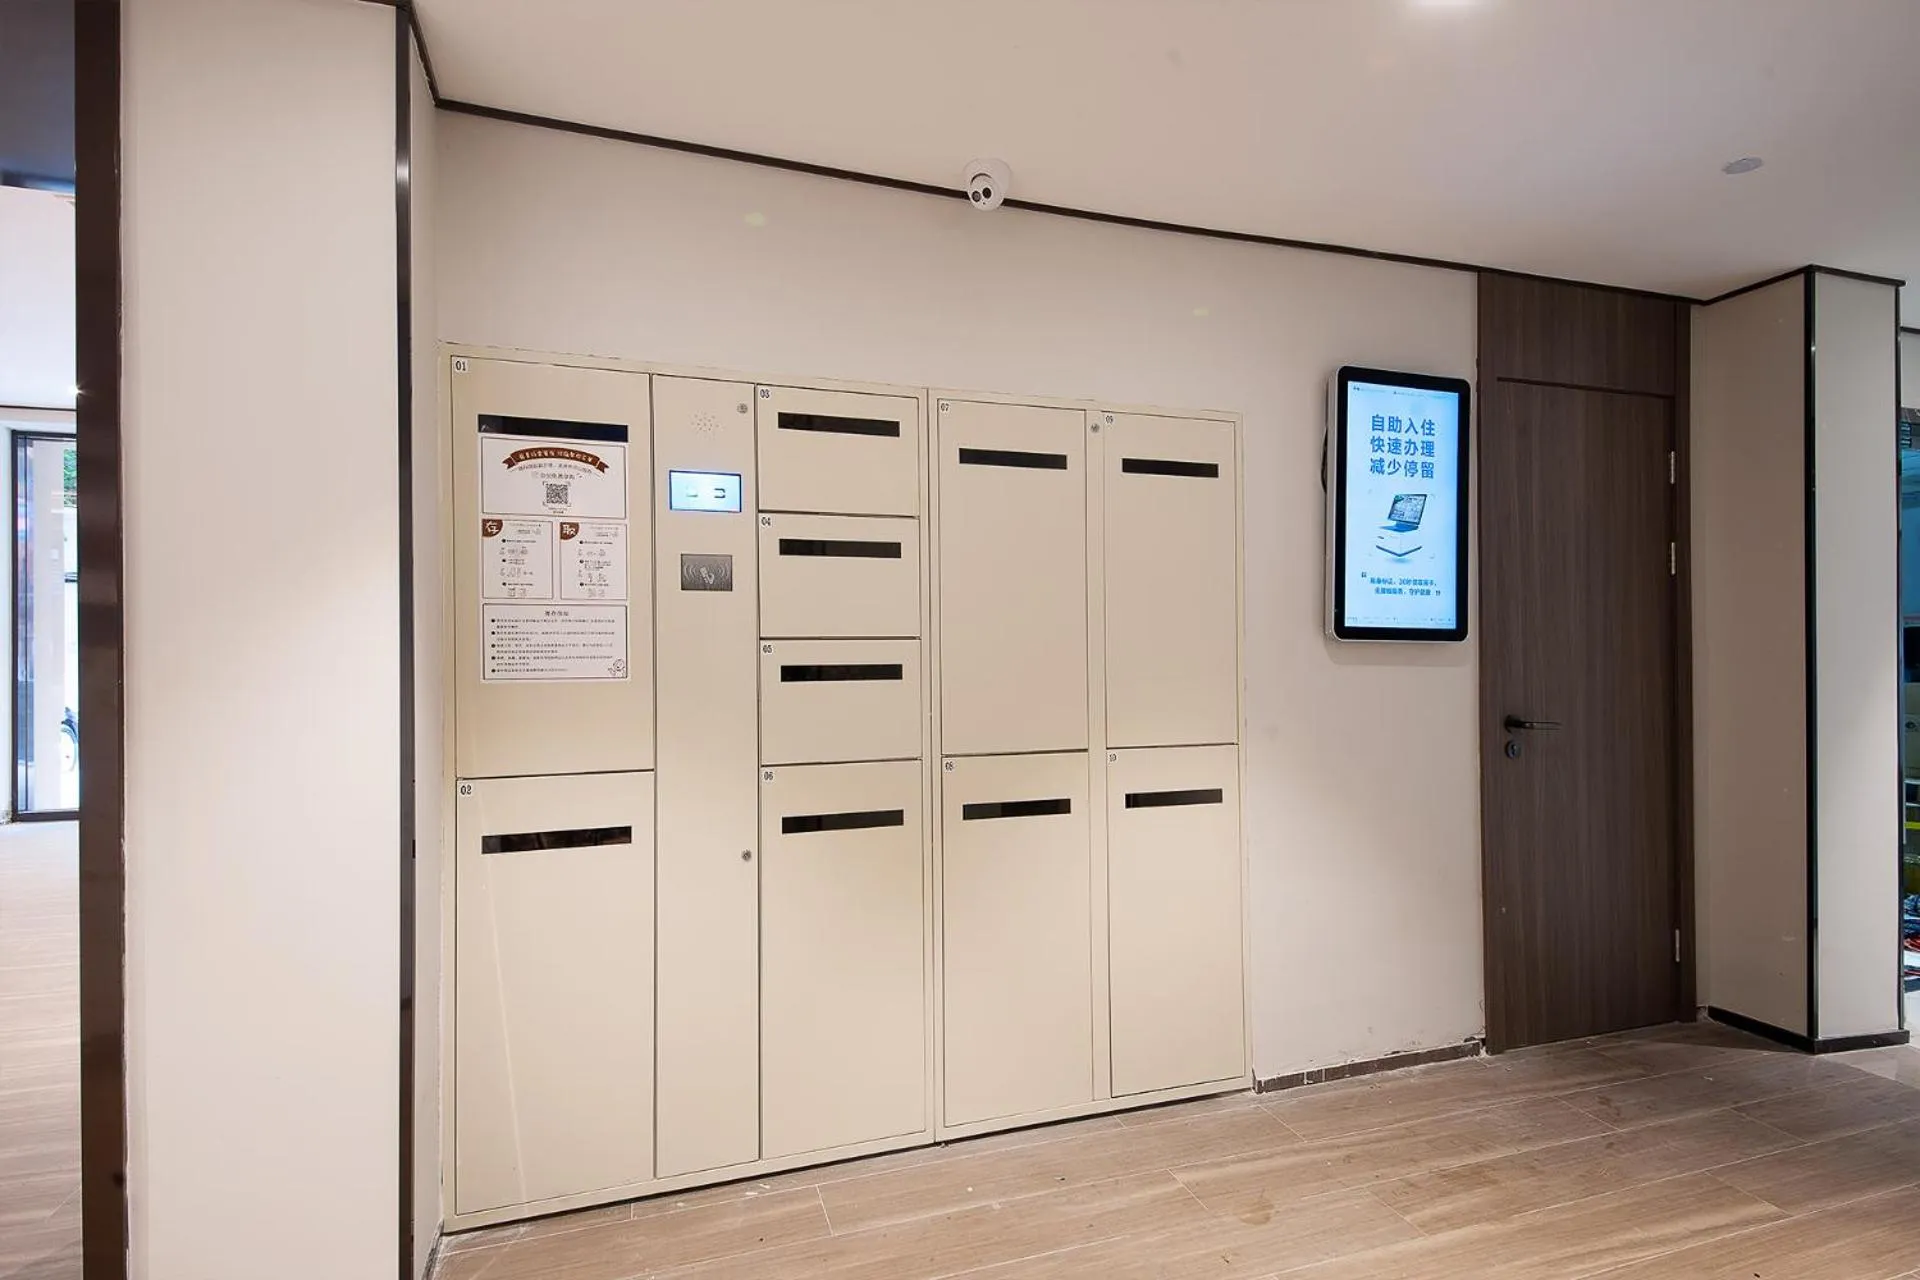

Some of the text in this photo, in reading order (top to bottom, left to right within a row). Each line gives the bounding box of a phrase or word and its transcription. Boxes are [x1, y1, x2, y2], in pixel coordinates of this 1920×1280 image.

[455, 360, 467, 371] 01
[760, 388, 770, 399] 03
[940, 402, 950, 412] 07
[1371, 413, 1435, 437] 自助入住
[1370, 435, 1435, 458] 快速办理
[1370, 457, 1434, 479] 减少停留
[761, 516, 771, 526] 04
[763, 644, 773, 654] 05
[764, 771, 774, 781] 06
[460, 784, 472, 795] 02
